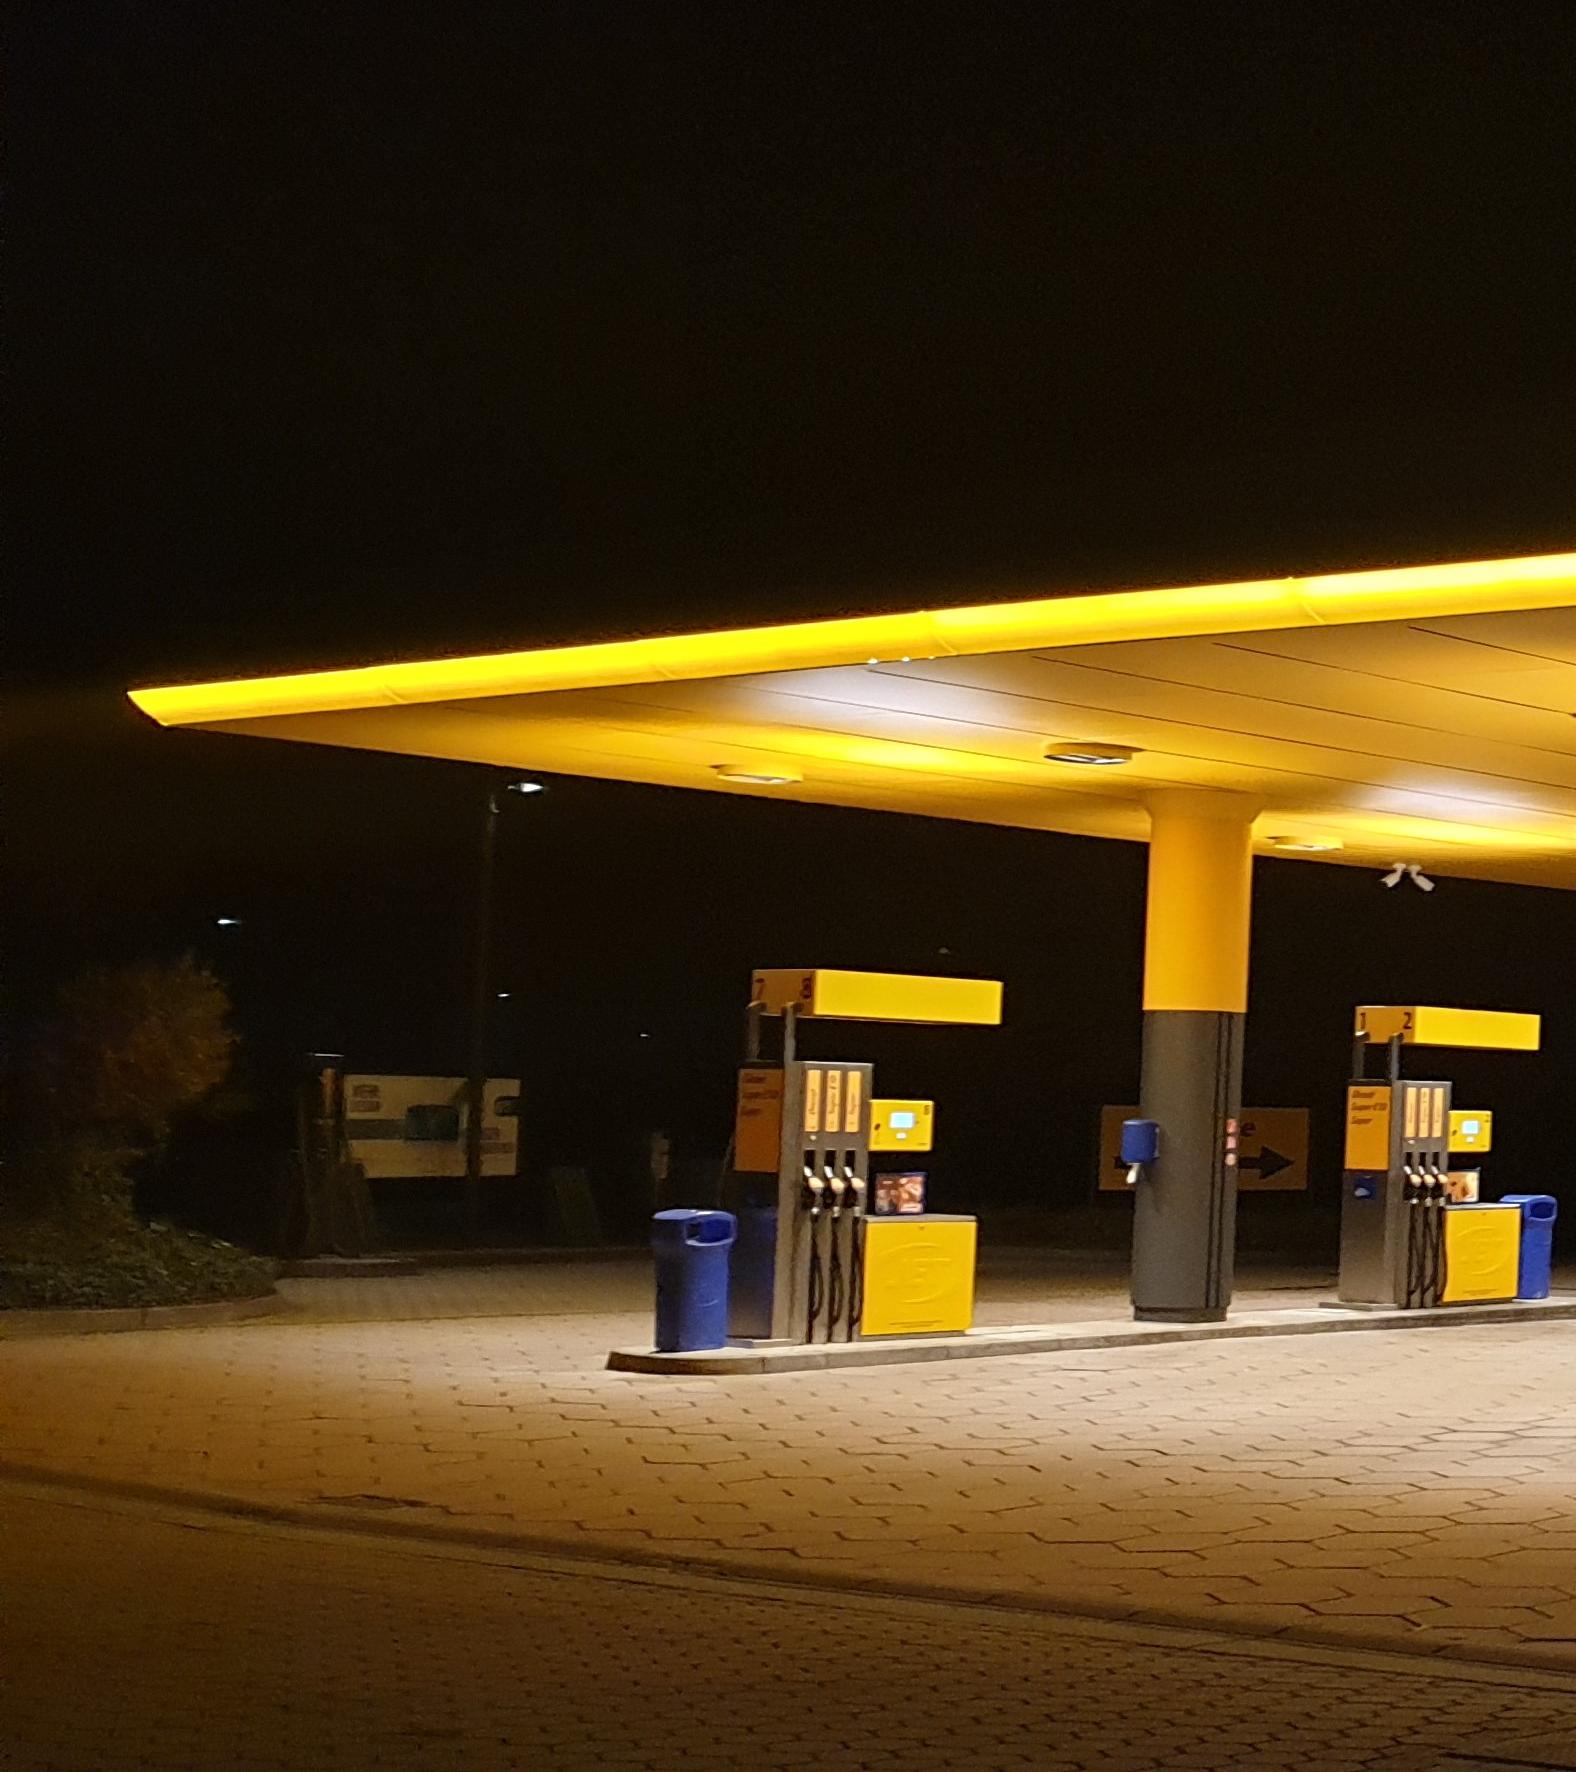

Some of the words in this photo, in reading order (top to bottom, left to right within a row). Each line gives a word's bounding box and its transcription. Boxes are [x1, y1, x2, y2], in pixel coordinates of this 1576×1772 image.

[754, 977, 766, 1000] 7
[1360, 1012, 1367, 1030] 1
[1403, 1012, 1412, 1030] 2
